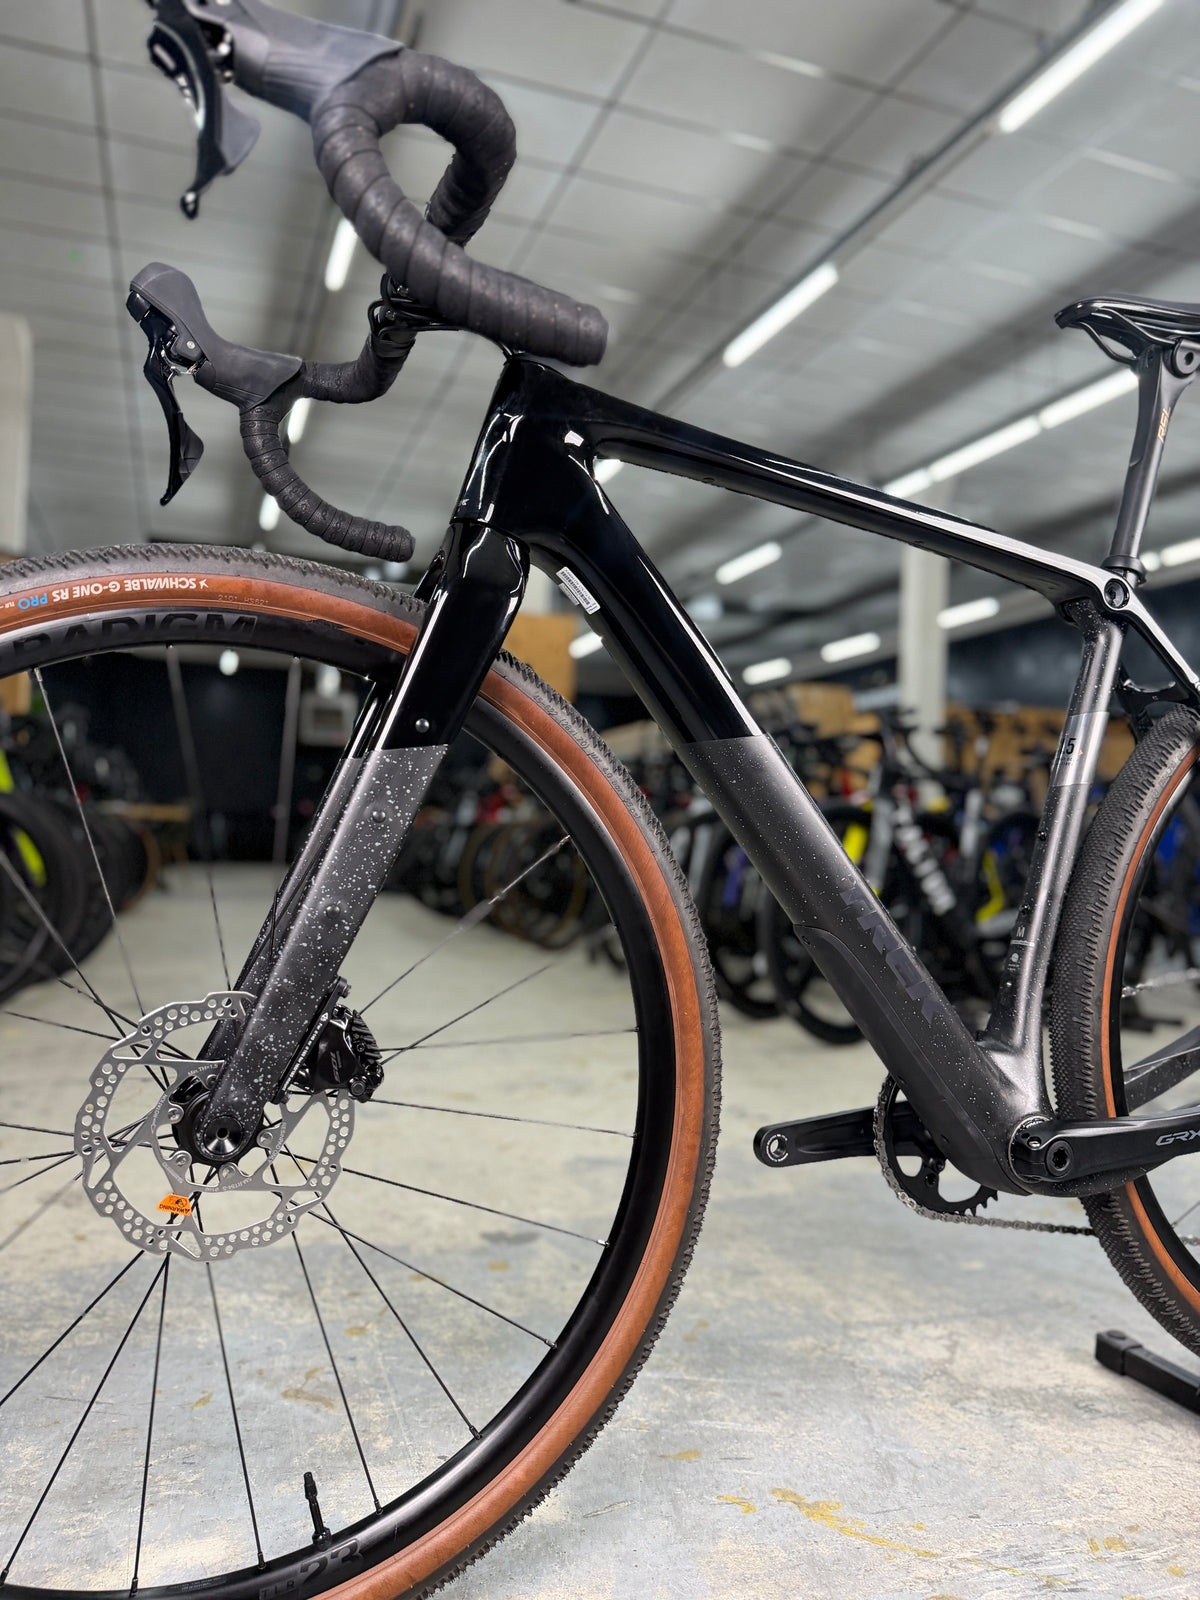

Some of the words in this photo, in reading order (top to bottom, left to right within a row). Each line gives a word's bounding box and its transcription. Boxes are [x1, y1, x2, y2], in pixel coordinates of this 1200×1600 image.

[72, 581, 121, 599] G-ONE
[124, 577, 197, 592] SCHWALBE
[17, 593, 48, 610] PRO
[52, 588, 69, 602] RS
